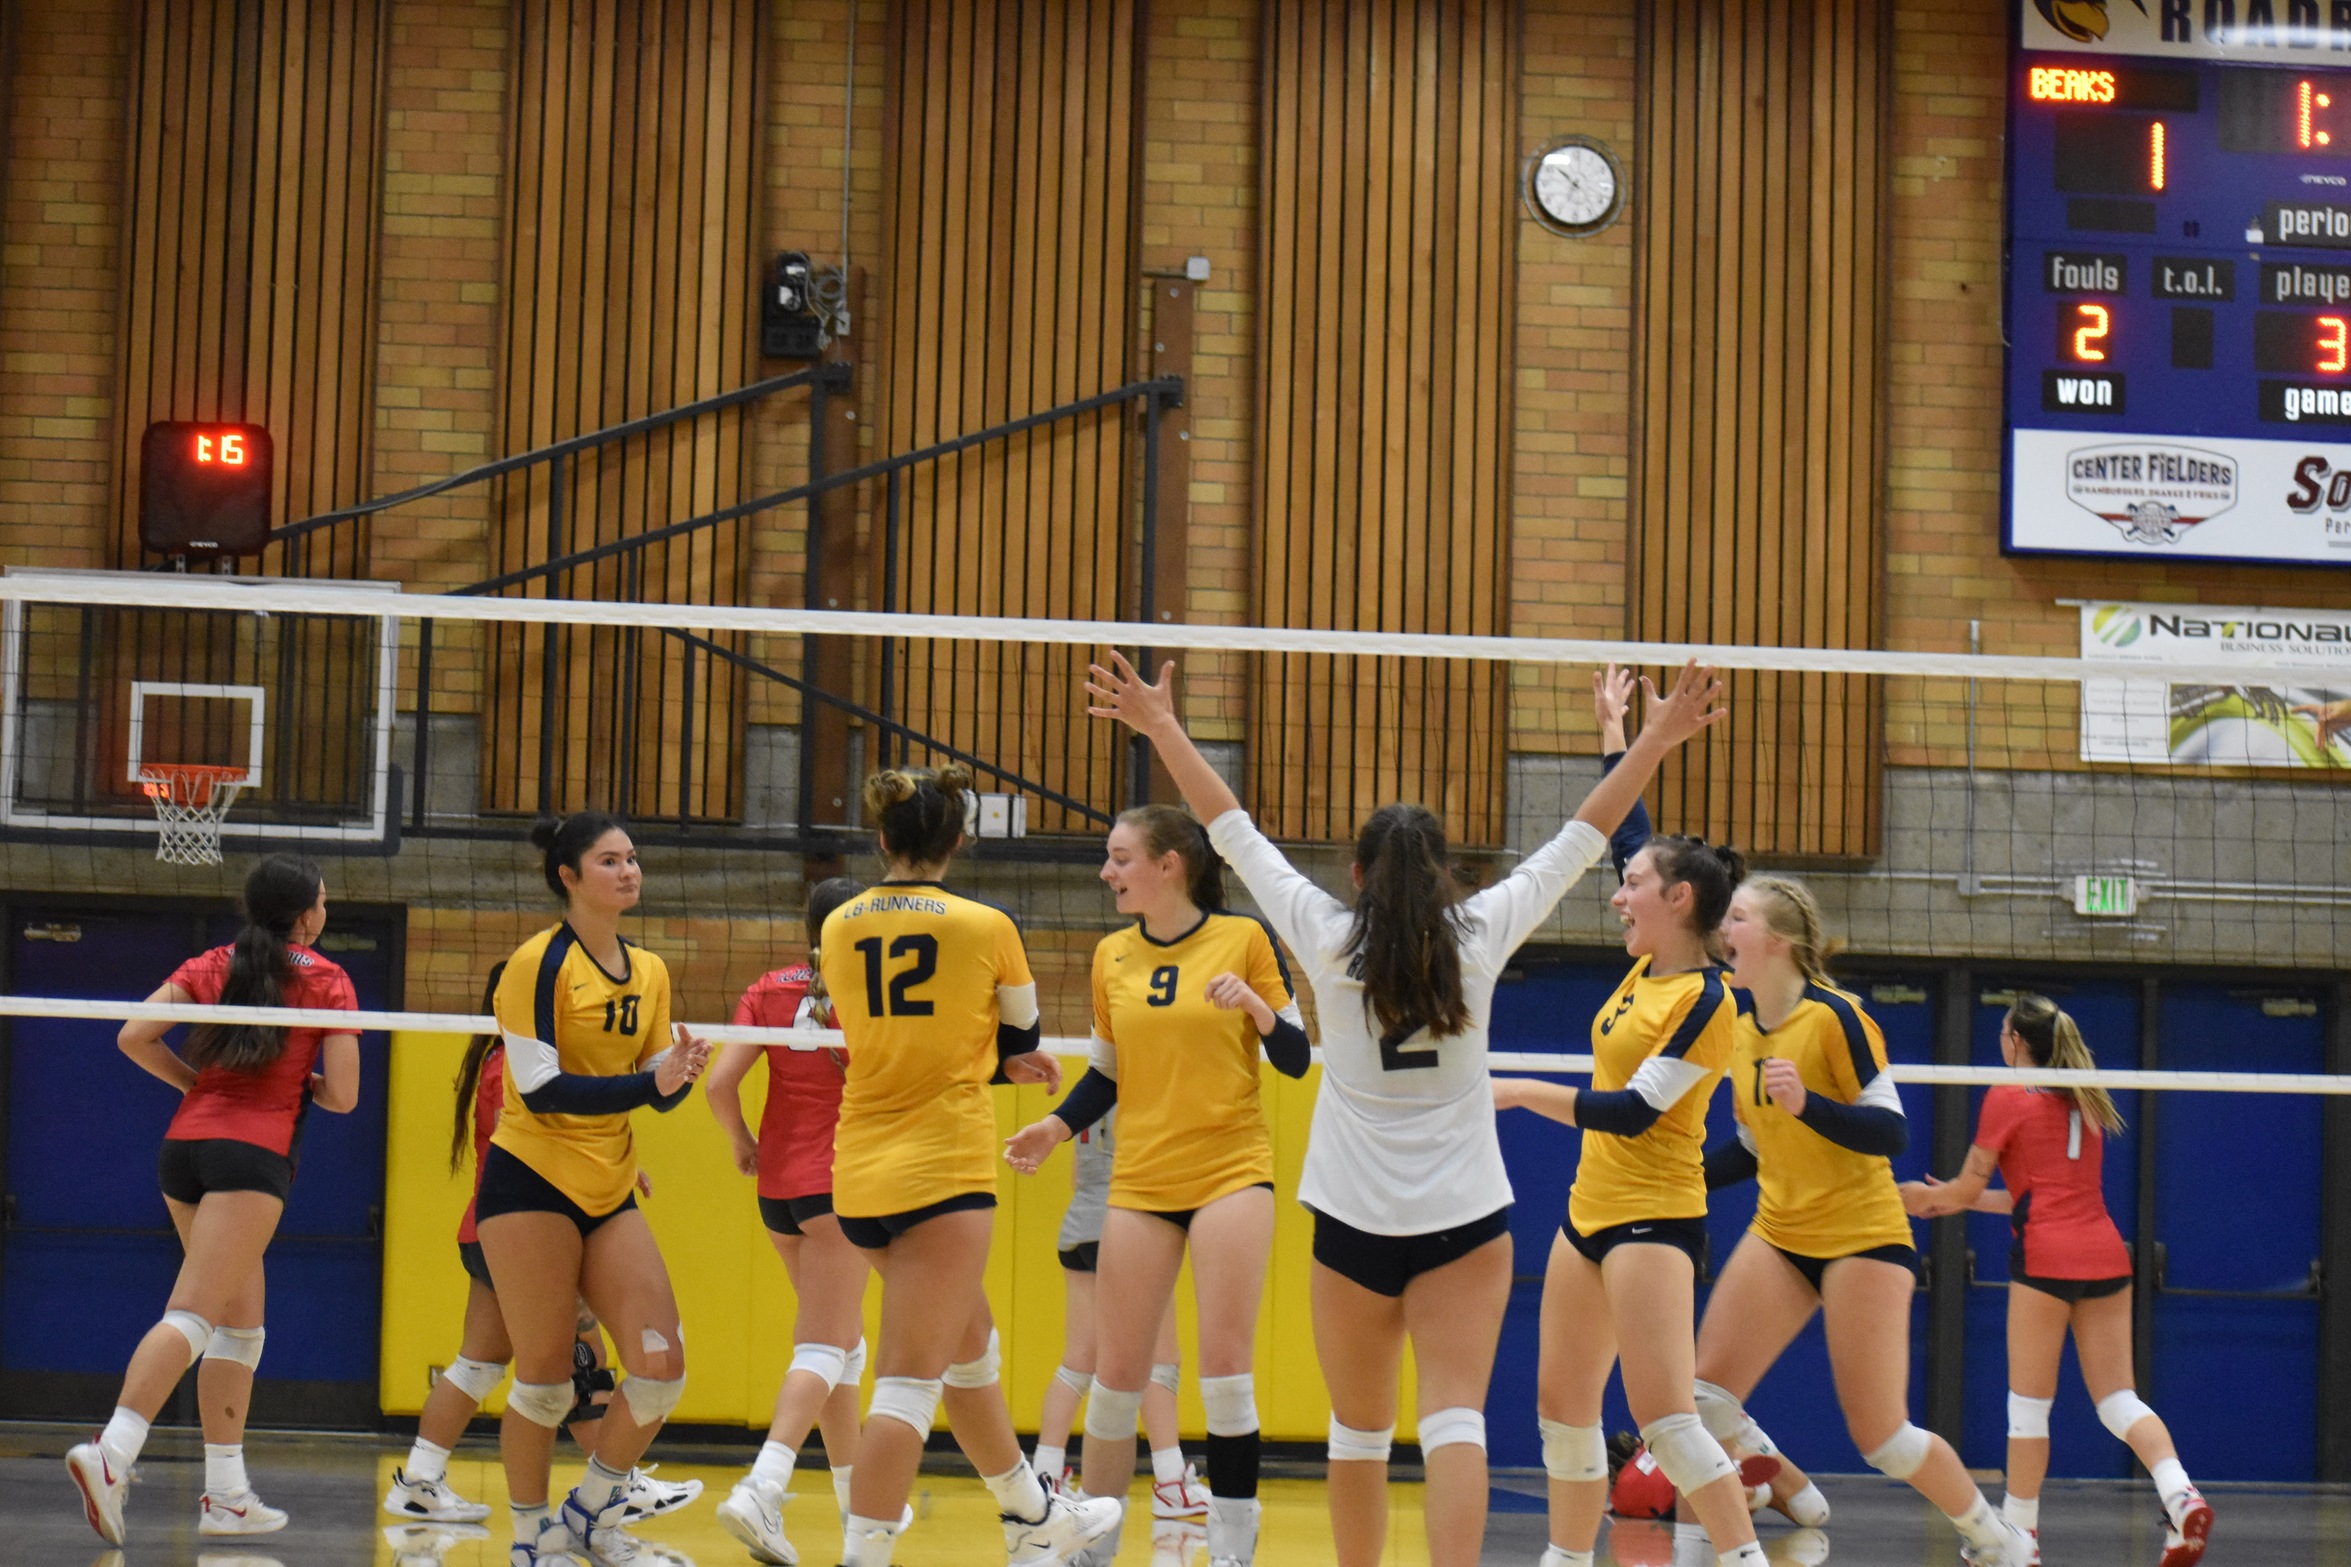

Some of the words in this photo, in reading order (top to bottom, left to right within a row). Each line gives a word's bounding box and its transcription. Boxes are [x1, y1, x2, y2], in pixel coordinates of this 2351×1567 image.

[2151, 121, 2165, 190] 1
[2052, 256, 2119, 292] fouls
[2276, 265, 2350, 304] playe
[2075, 304, 2109, 361] 2
[2317, 317, 2347, 372] 3
[2056, 378, 2113, 407] won
[2284, 387, 2351, 422] game
[2072, 454, 2143, 482] CENTER
[2220, 640, 2284, 654] BUSINESS
[2086, 877, 2127, 912] EXIT
[854, 933, 938, 1018] 12
[1146, 965, 1179, 1007] 9
[602, 995, 641, 1036] 10
[2066, 1109, 2082, 1160] 1
